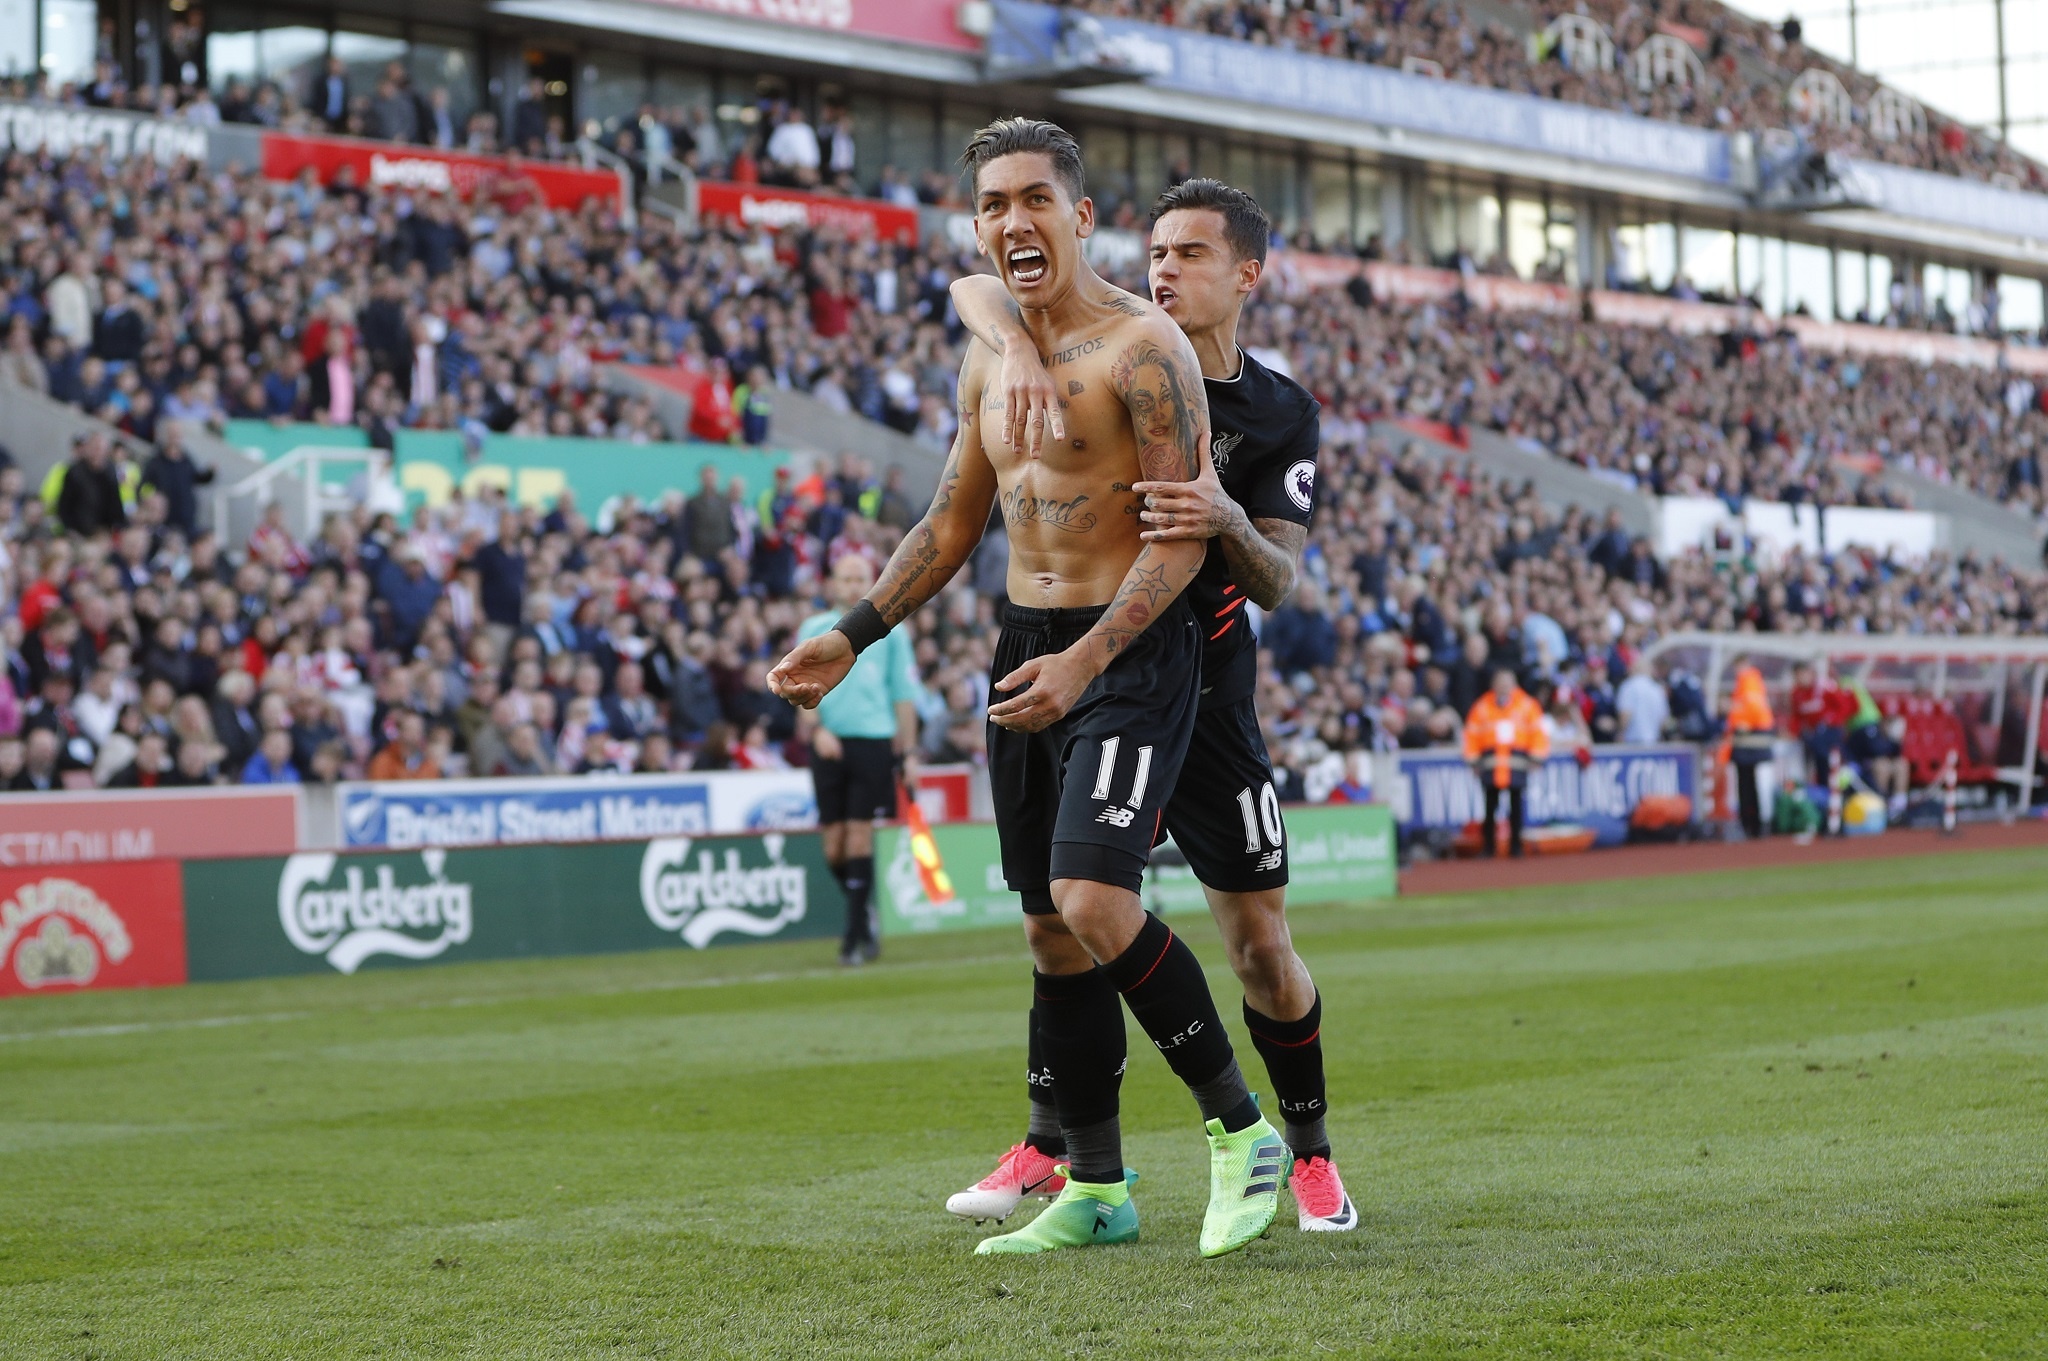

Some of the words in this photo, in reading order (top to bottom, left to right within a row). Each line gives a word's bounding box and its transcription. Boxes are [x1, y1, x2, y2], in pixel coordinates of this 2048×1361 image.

[1002, 484, 1097, 533] Blessed
[1091, 736, 1153, 810] 11
[601, 794, 706, 840] Motors
[1236, 781, 1282, 853] 10
[277, 849, 473, 956] Carlsberg
[639, 836, 807, 931] Carlsberg
